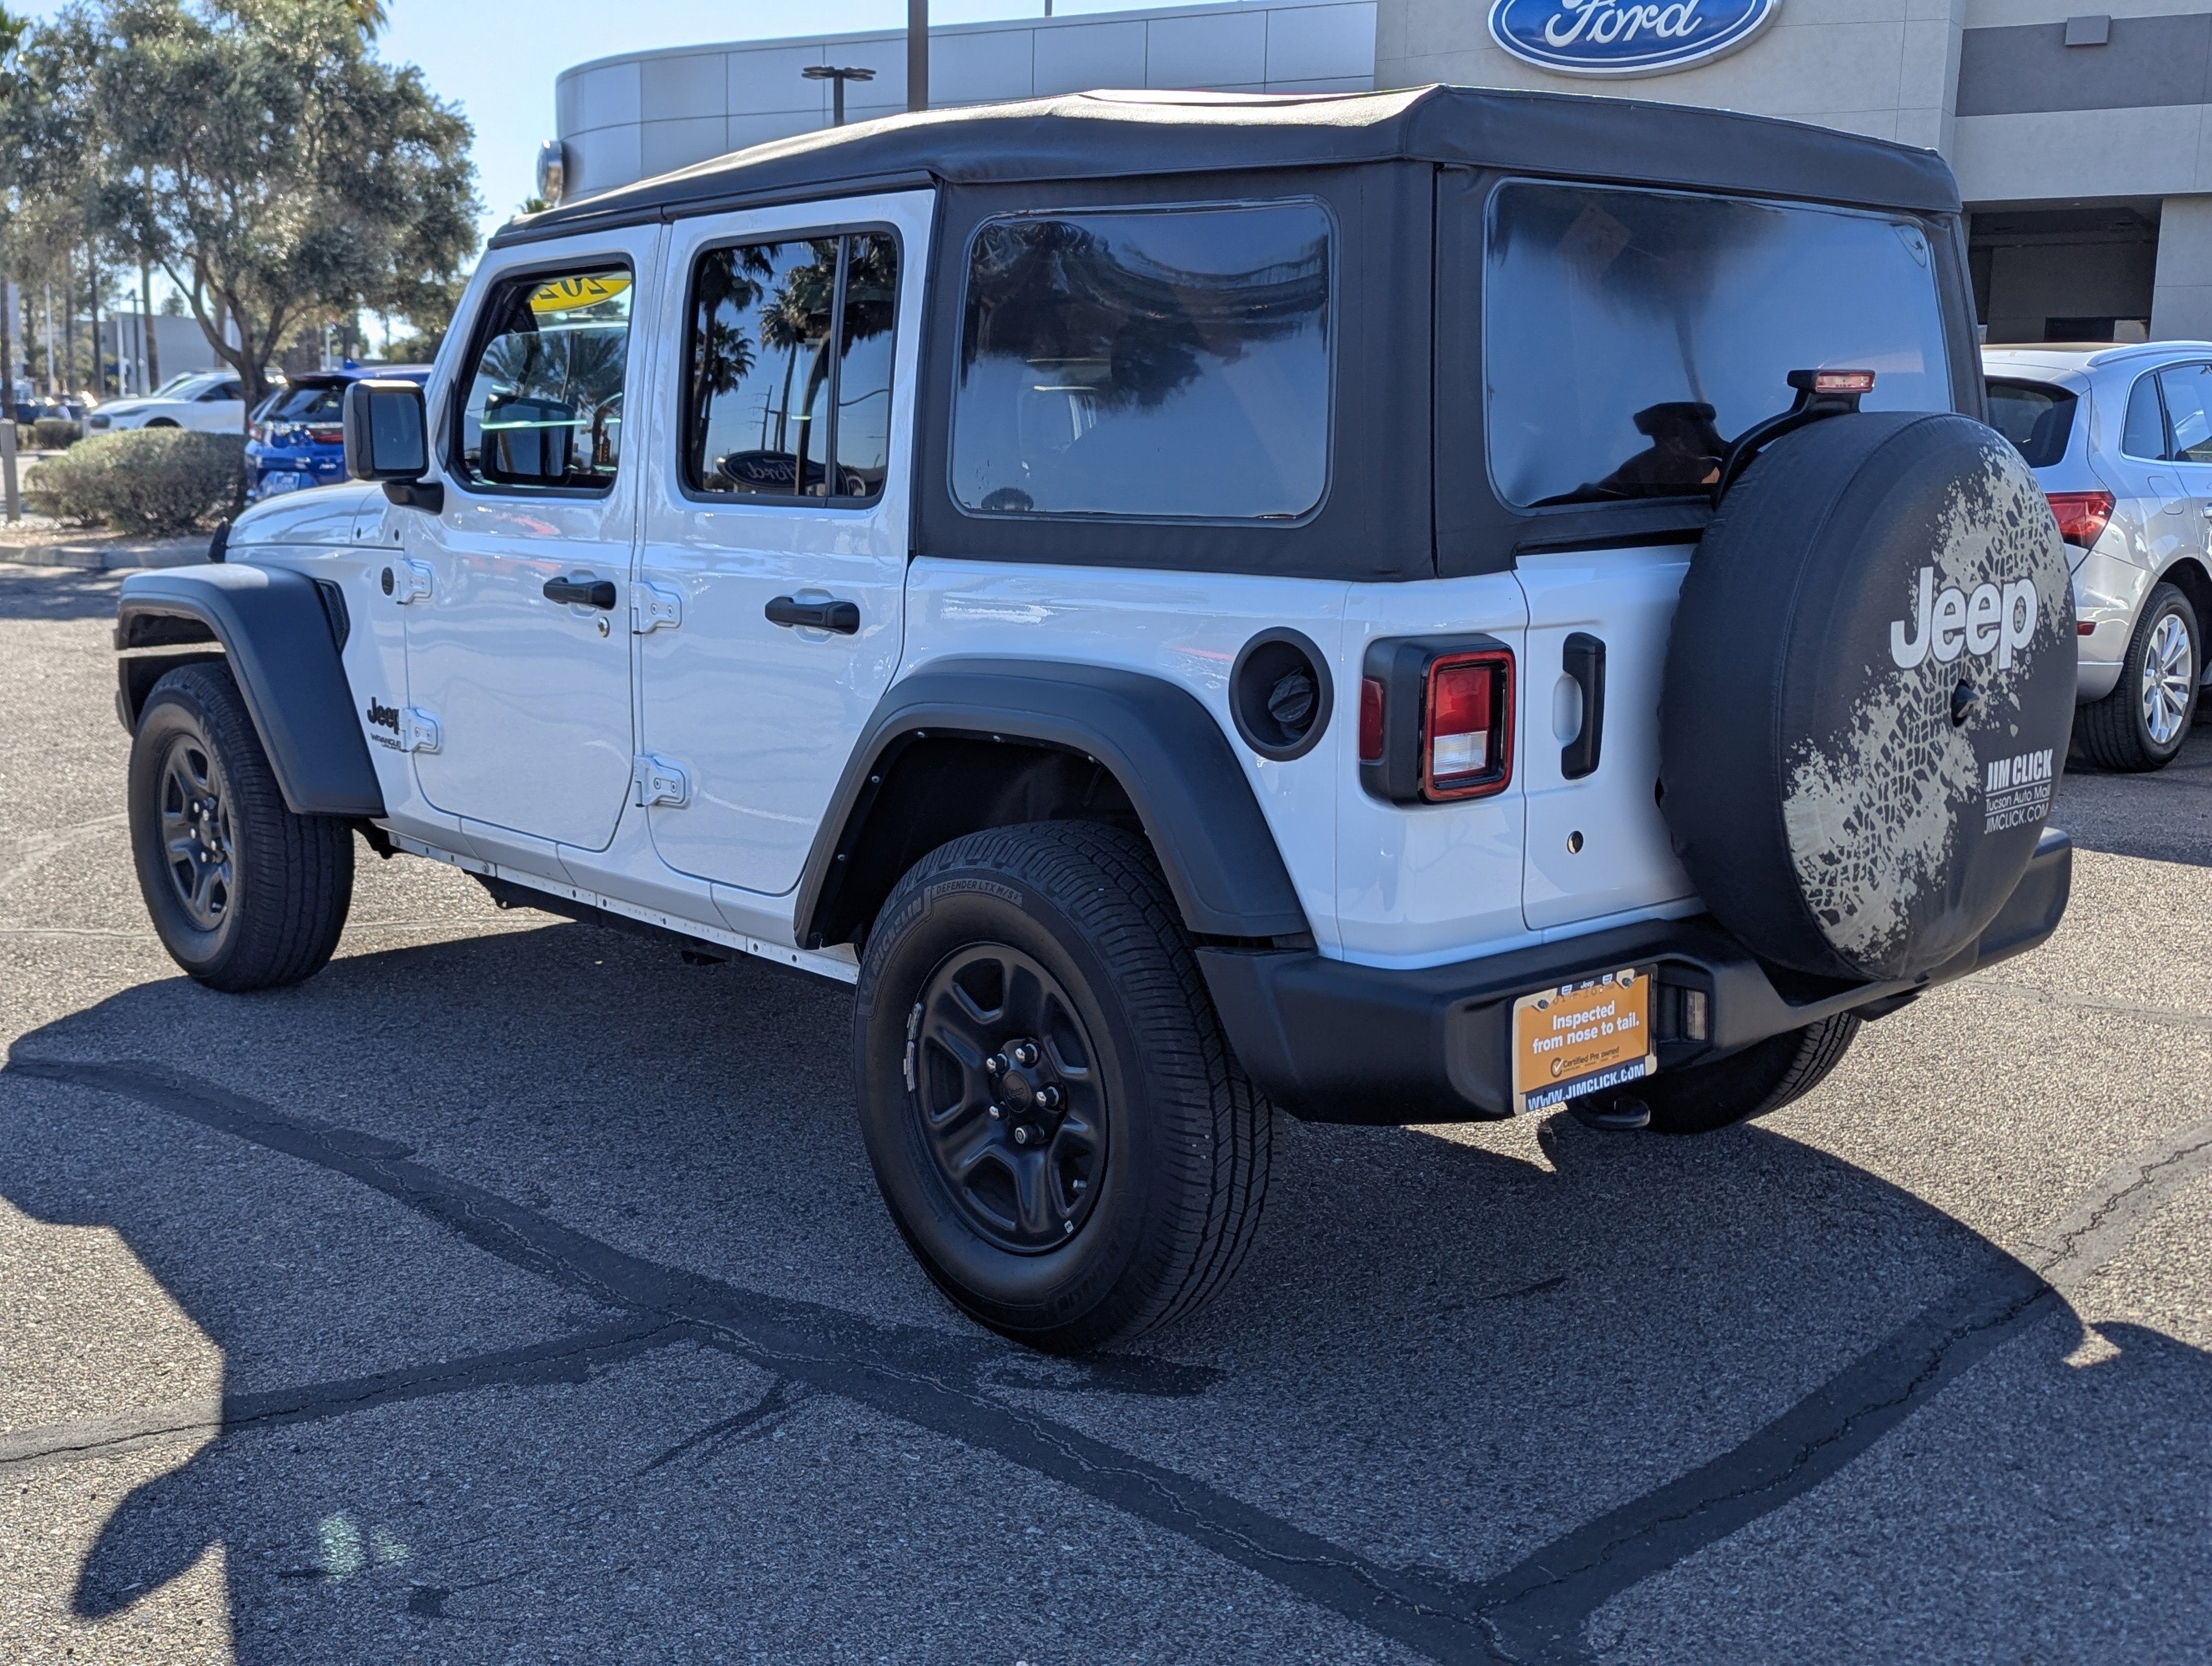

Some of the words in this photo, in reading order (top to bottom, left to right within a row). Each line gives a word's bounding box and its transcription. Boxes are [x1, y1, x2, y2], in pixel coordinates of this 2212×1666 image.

[1545, 0, 1702, 47] Ford
[1891, 567, 2038, 669] Jeep
[370, 733, 401, 747] WRANGLE
[1985, 758, 2011, 792] JIM
[2012, 748, 2053, 785] CLICK
[1985, 796, 2011, 812] Tucson
[2013, 789, 2032, 805] Auto
[2034, 784, 2051, 799] Mall
[1984, 802, 2049, 835] JIMCLICK.COM
[936, 880, 978, 894] DEFENDER
[979, 881, 995, 893] LTX
[1553, 1000, 1615, 1030] Inspected
[1533, 1033, 1563, 1054] from
[1567, 1027, 1597, 1045] nose
[1600, 1020, 1614, 1035] to
[1617, 1013, 1639, 1031] tail.
[1563, 1055, 1589, 1068] Certified
[1528, 1062, 1645, 1111] WWW.JIMCLICK.COM
